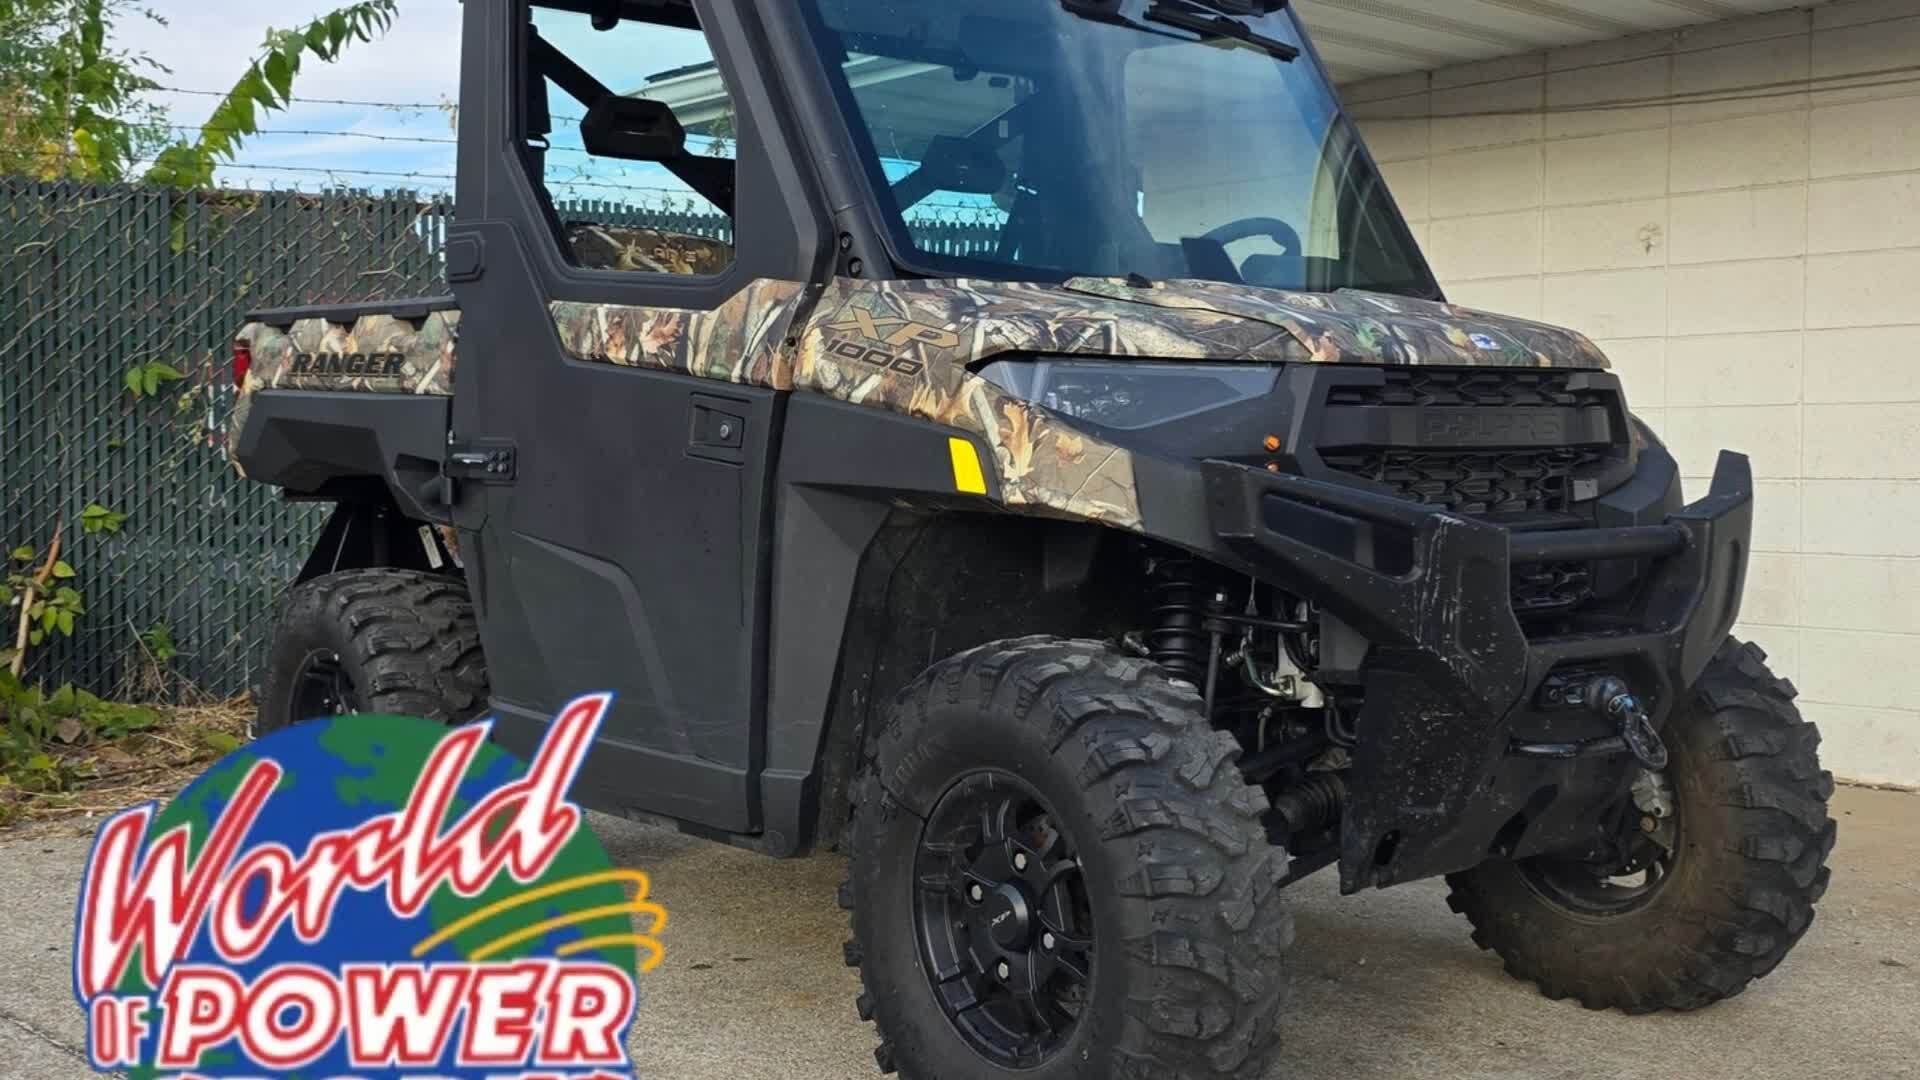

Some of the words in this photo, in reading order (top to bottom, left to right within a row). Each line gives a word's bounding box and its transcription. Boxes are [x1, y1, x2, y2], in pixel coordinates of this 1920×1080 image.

[827, 304, 960, 349] XP
[292, 352, 406, 375] RANGER
[826, 338, 924, 377] 1000
